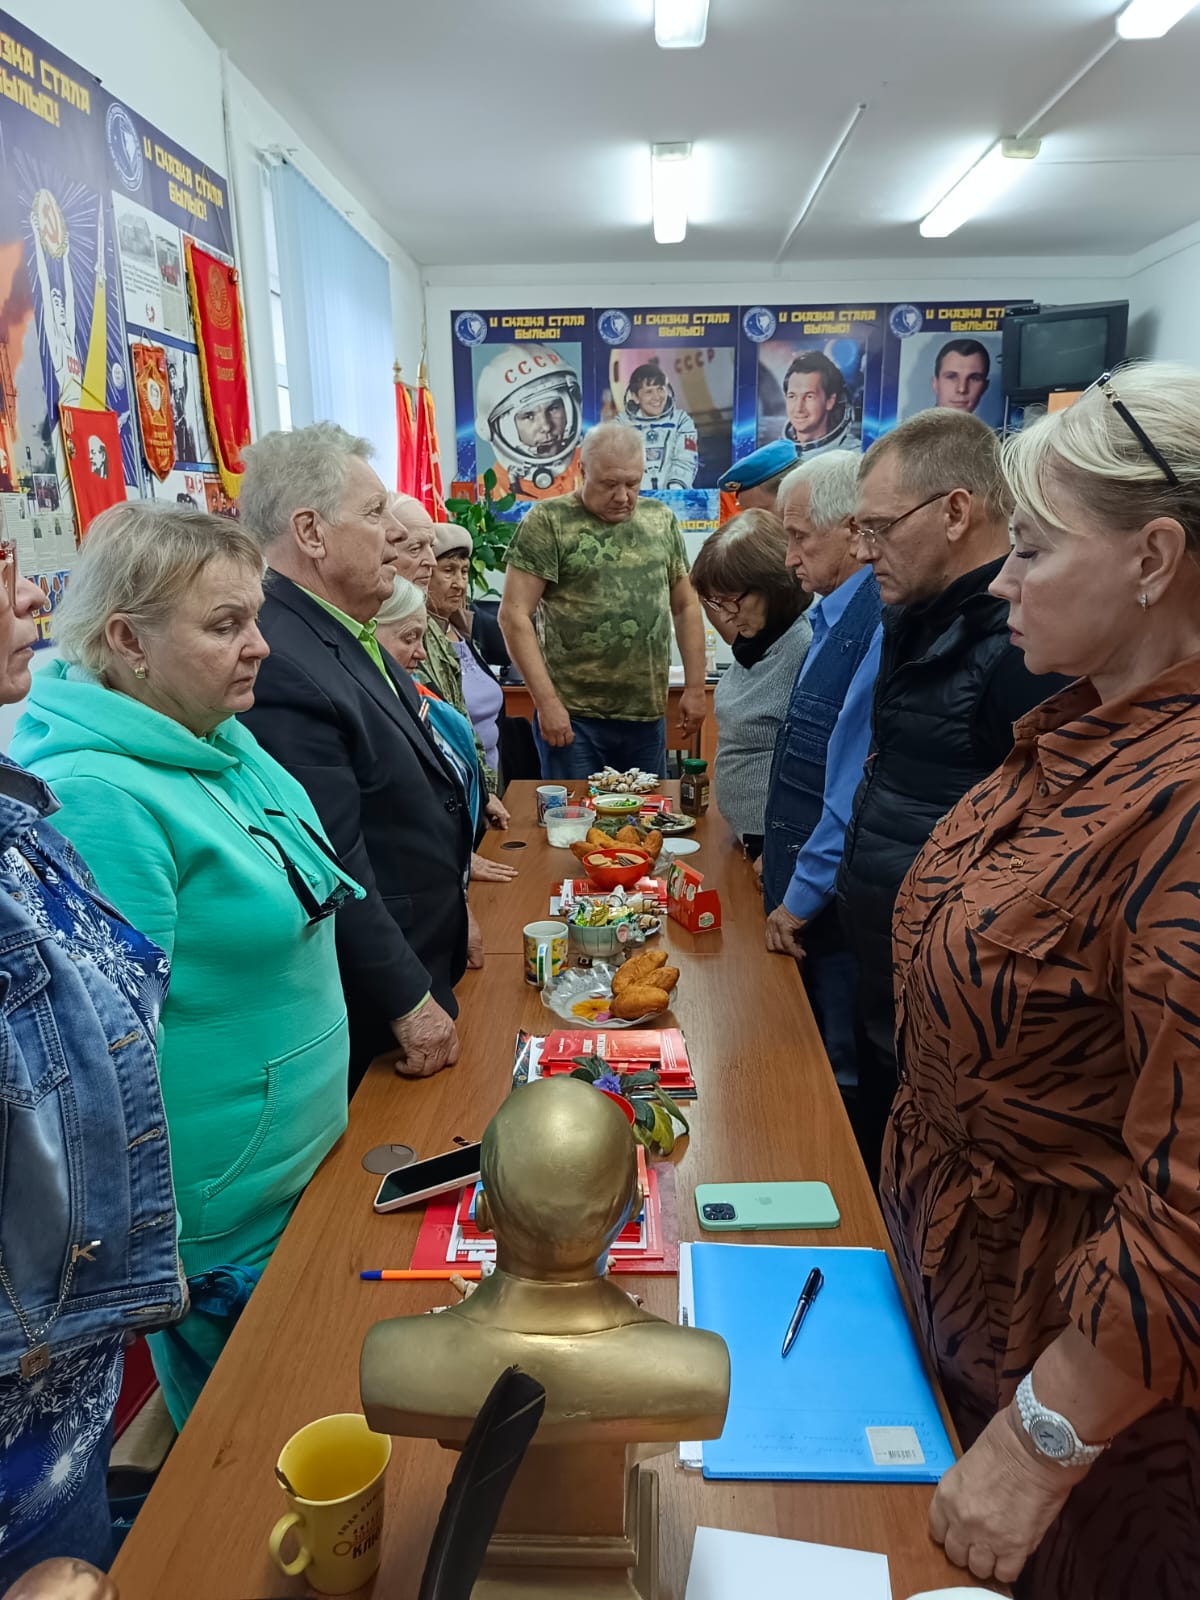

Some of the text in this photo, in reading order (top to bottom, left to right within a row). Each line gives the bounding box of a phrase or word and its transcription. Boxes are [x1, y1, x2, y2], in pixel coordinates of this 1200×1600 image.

[0, 32, 91, 115] ЗКА СТАЛА
[154, 144, 193, 189] СКАЗКА
[194, 173, 224, 210] СТАЛА
[645, 313, 690, 325] СКАЗКА
[692, 312, 731, 324] СТАЛА
[791, 310, 836, 322] СКАЗКА
[838, 309, 877, 321] СТАЛА
[938, 307, 982, 320] СКАЗКА
[501, 316, 545, 328] СКАЗКА
[548, 315, 586, 327] СТАЛА
[504, 352, 559, 384] СССР
